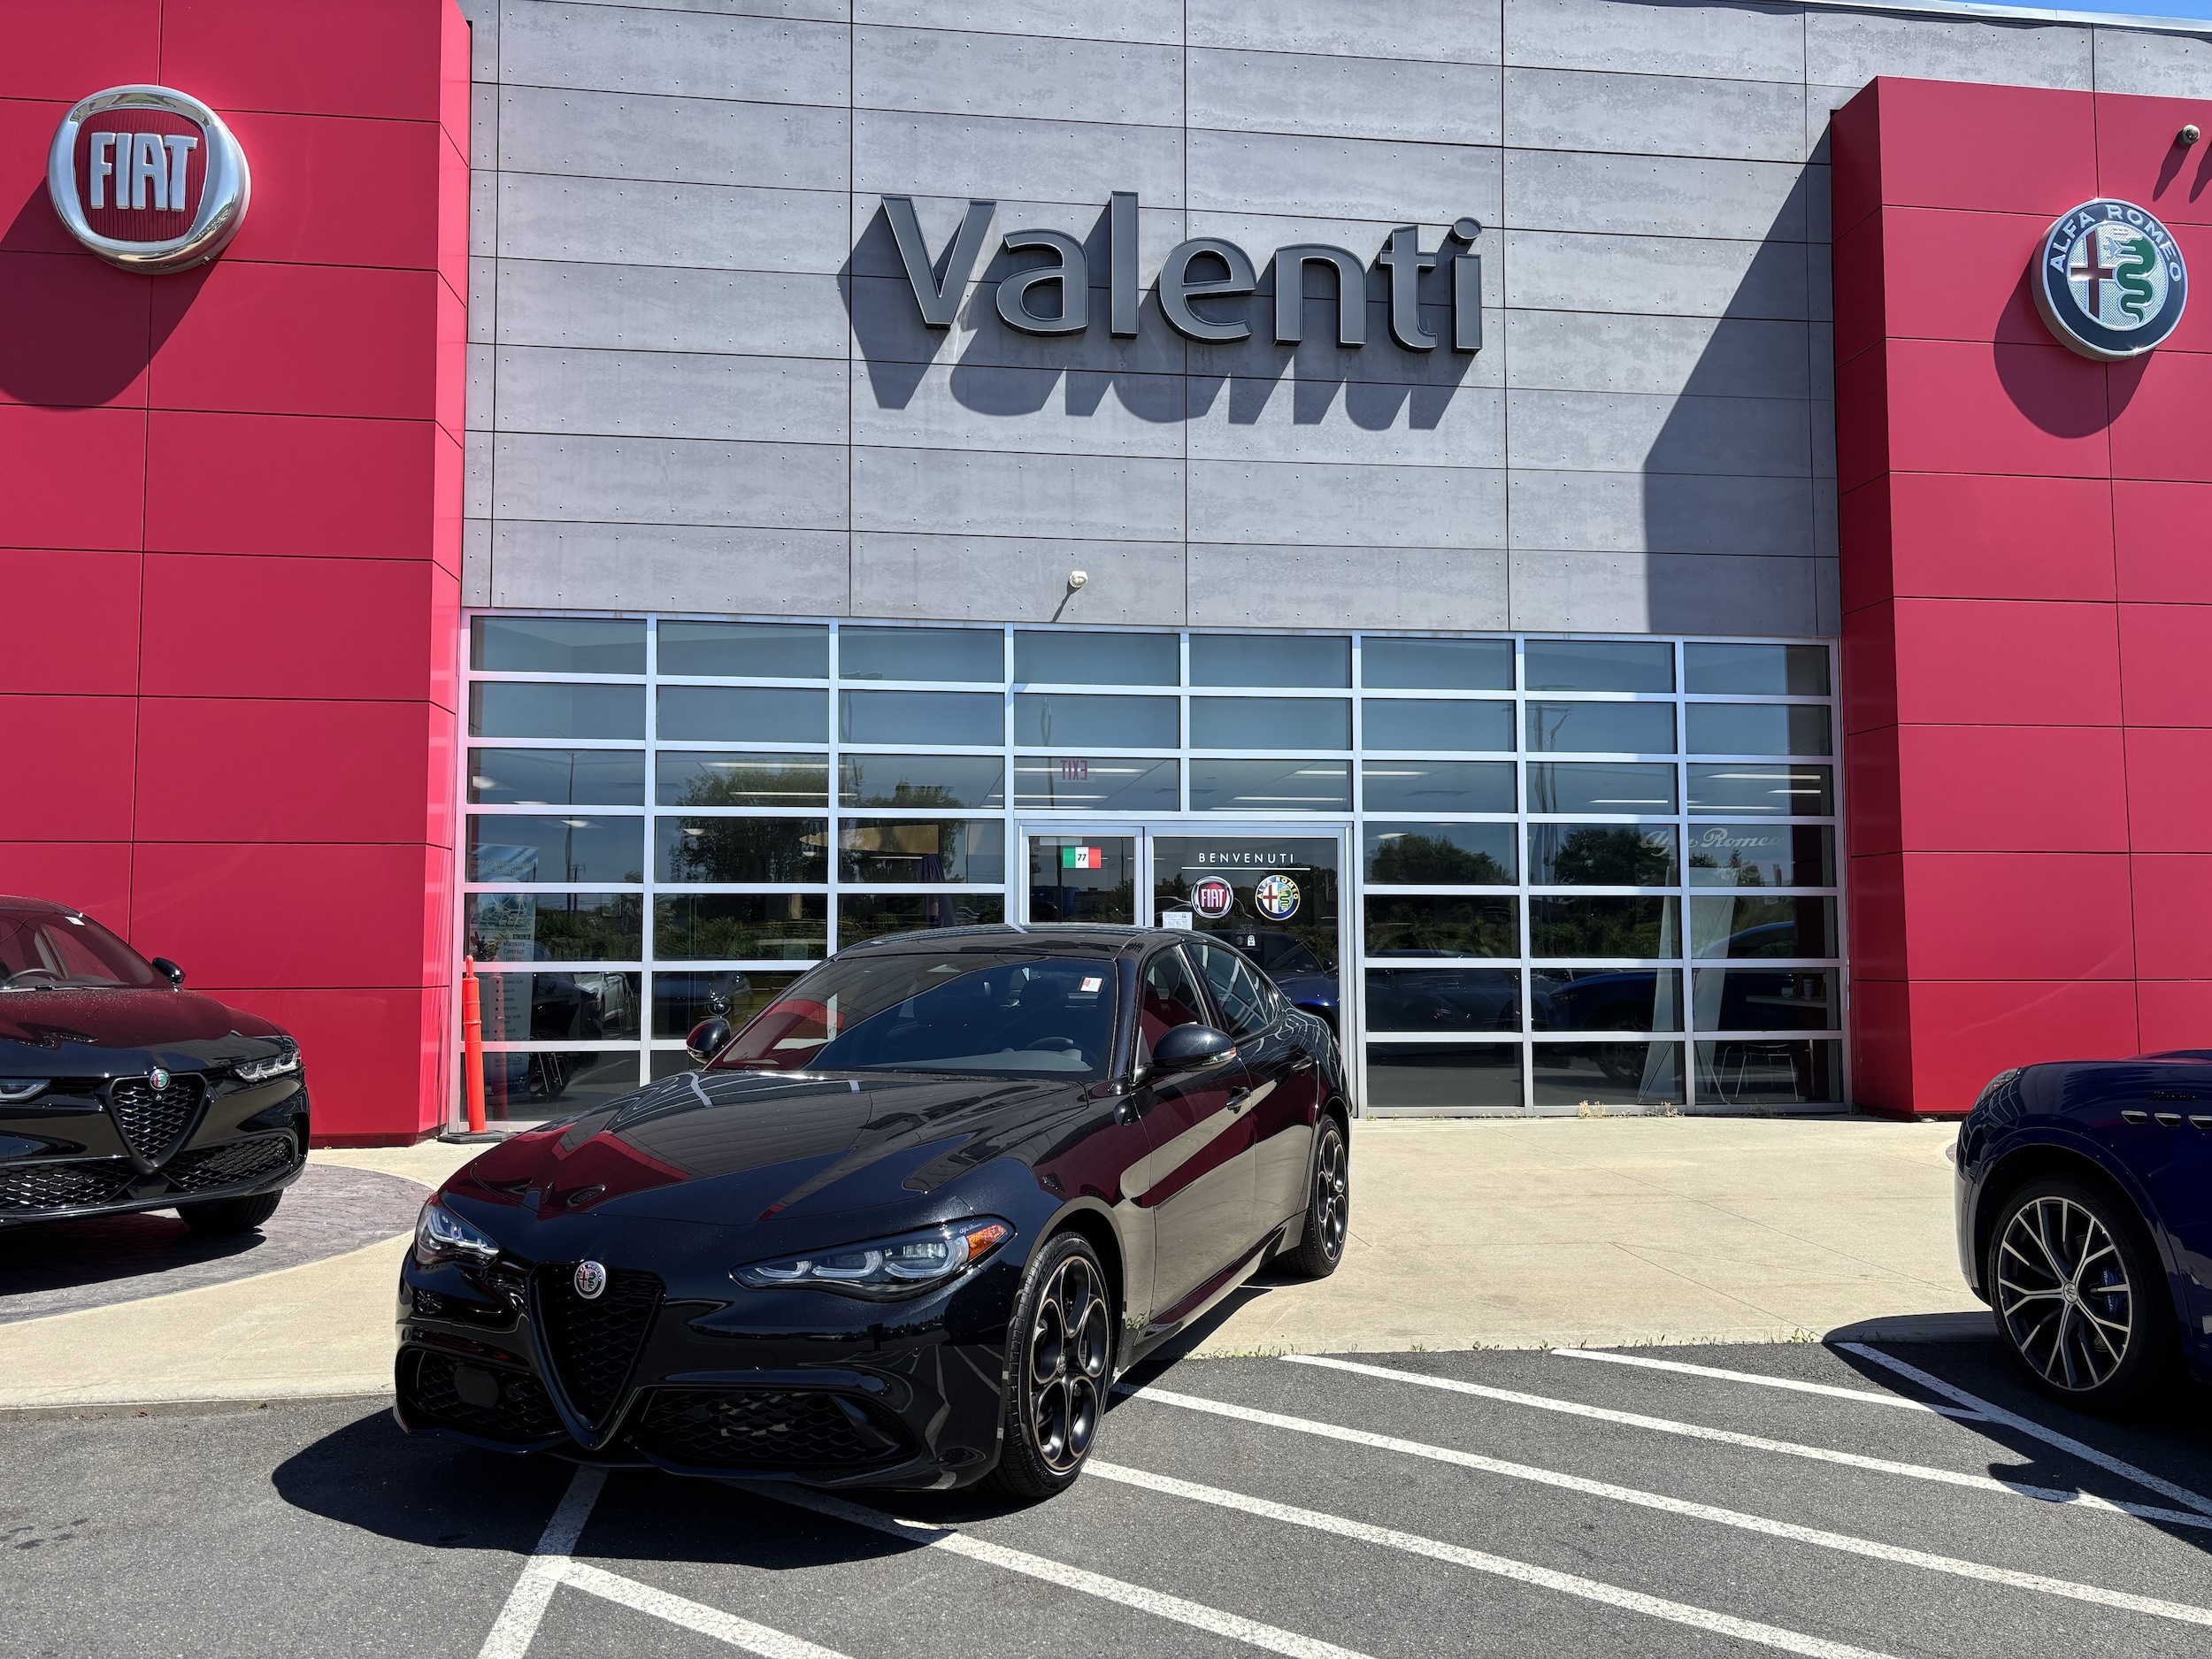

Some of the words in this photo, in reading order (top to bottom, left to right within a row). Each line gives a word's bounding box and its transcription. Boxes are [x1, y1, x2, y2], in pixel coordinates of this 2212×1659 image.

[90, 132, 198, 212] FIAT
[2049, 211, 2095, 273] ALFA
[2106, 204, 2182, 281] ROMEO
[881, 190, 1482, 353] Valenti
[1701, 827, 1785, 849] Romeo
[1077, 853, 1087, 862] 77
[1198, 853, 1294, 864] BENVENUTI
[1201, 888, 1225, 908] FIAT
[1257, 879, 1272, 899] ALFA
[1276, 877, 1298, 900] ROMEO
